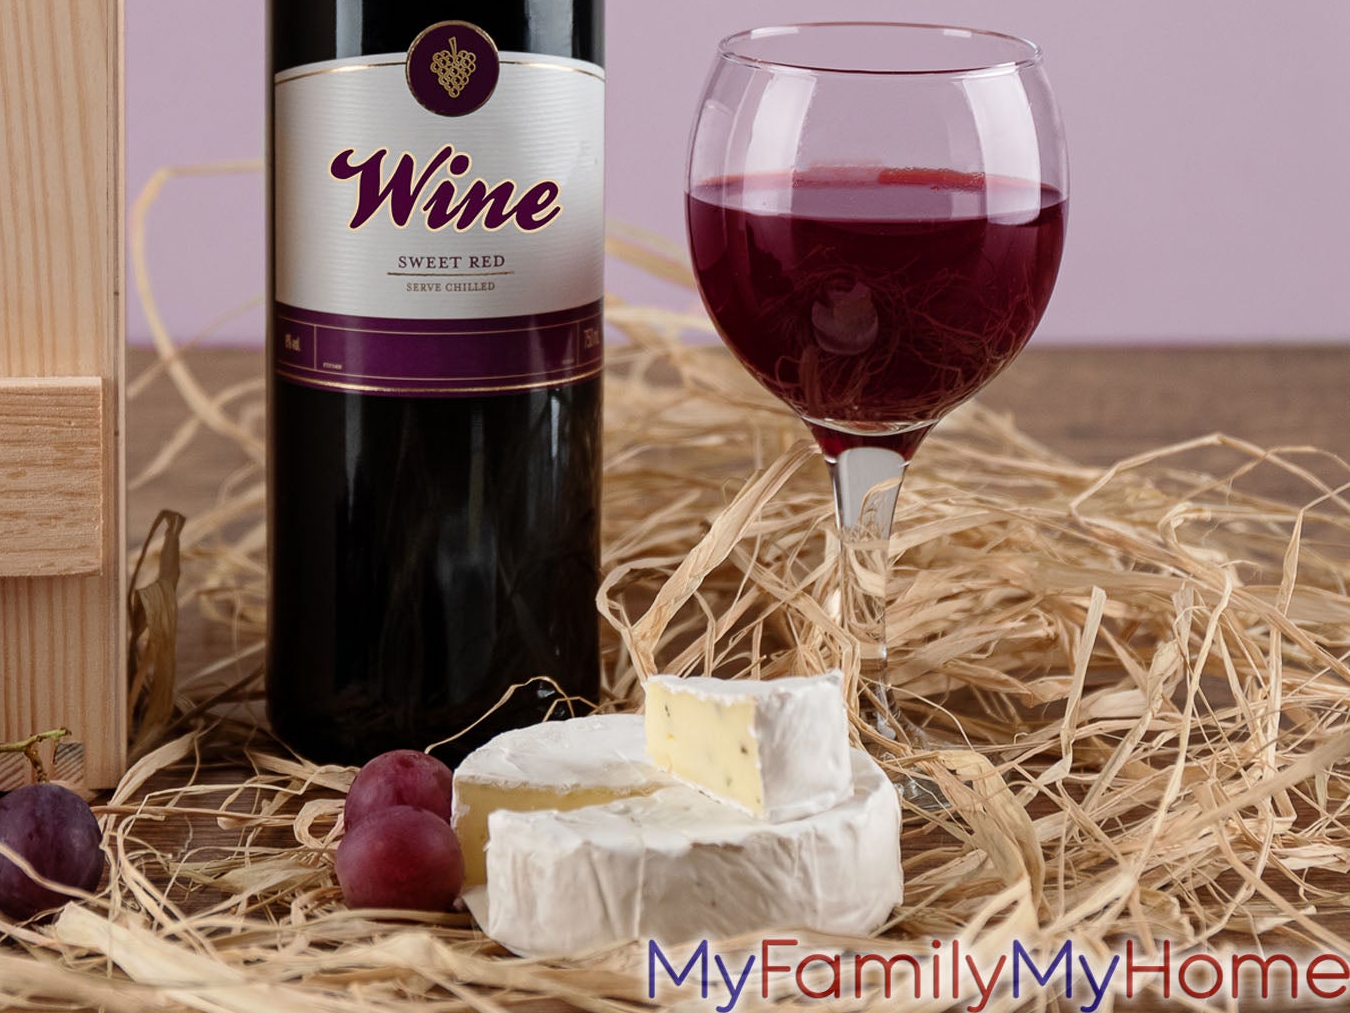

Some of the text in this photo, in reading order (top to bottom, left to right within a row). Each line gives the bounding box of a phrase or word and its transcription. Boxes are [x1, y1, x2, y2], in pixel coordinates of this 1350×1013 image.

[328, 143, 563, 233] Wine
[398, 255, 505, 269] SWEET RED
[406, 282, 496, 292] SERVE CHILLED
